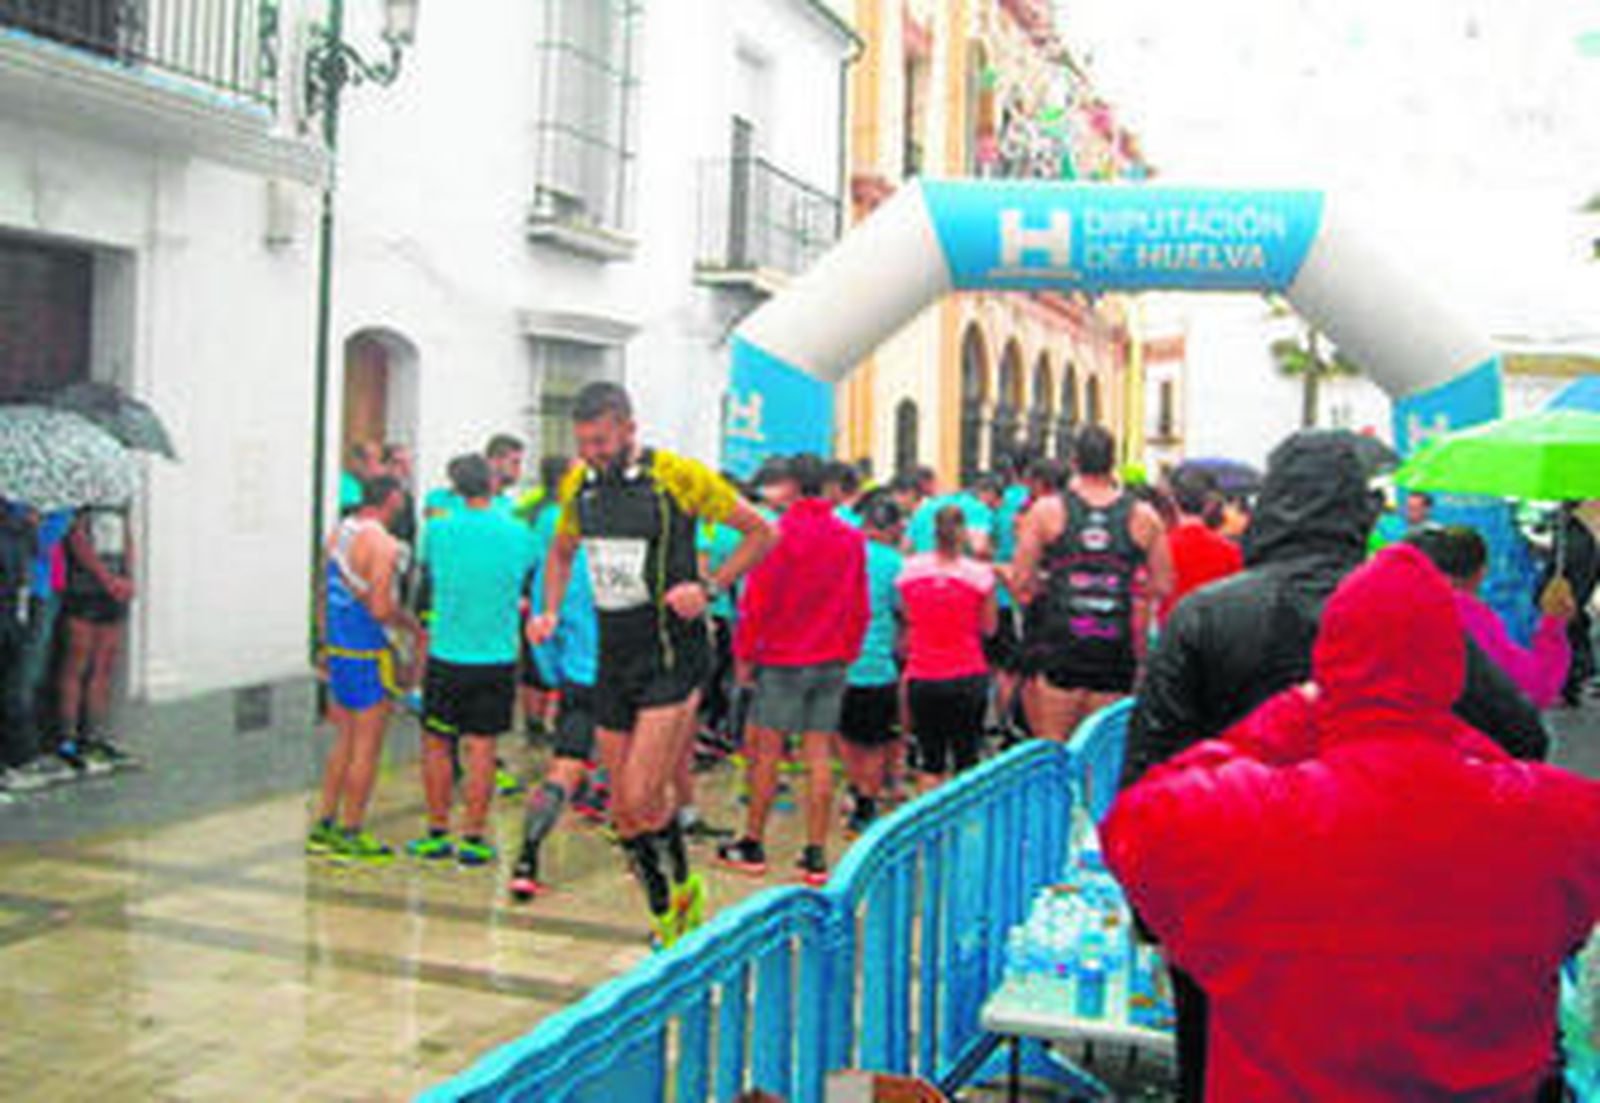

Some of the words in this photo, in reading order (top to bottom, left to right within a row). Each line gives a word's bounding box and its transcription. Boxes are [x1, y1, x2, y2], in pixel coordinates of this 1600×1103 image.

[1001, 210, 1070, 266] H
[1084, 206, 1286, 238] DIPUTACIÓN
[1084, 244, 1124, 271] DE
[1138, 243, 1265, 271] HUELVA
